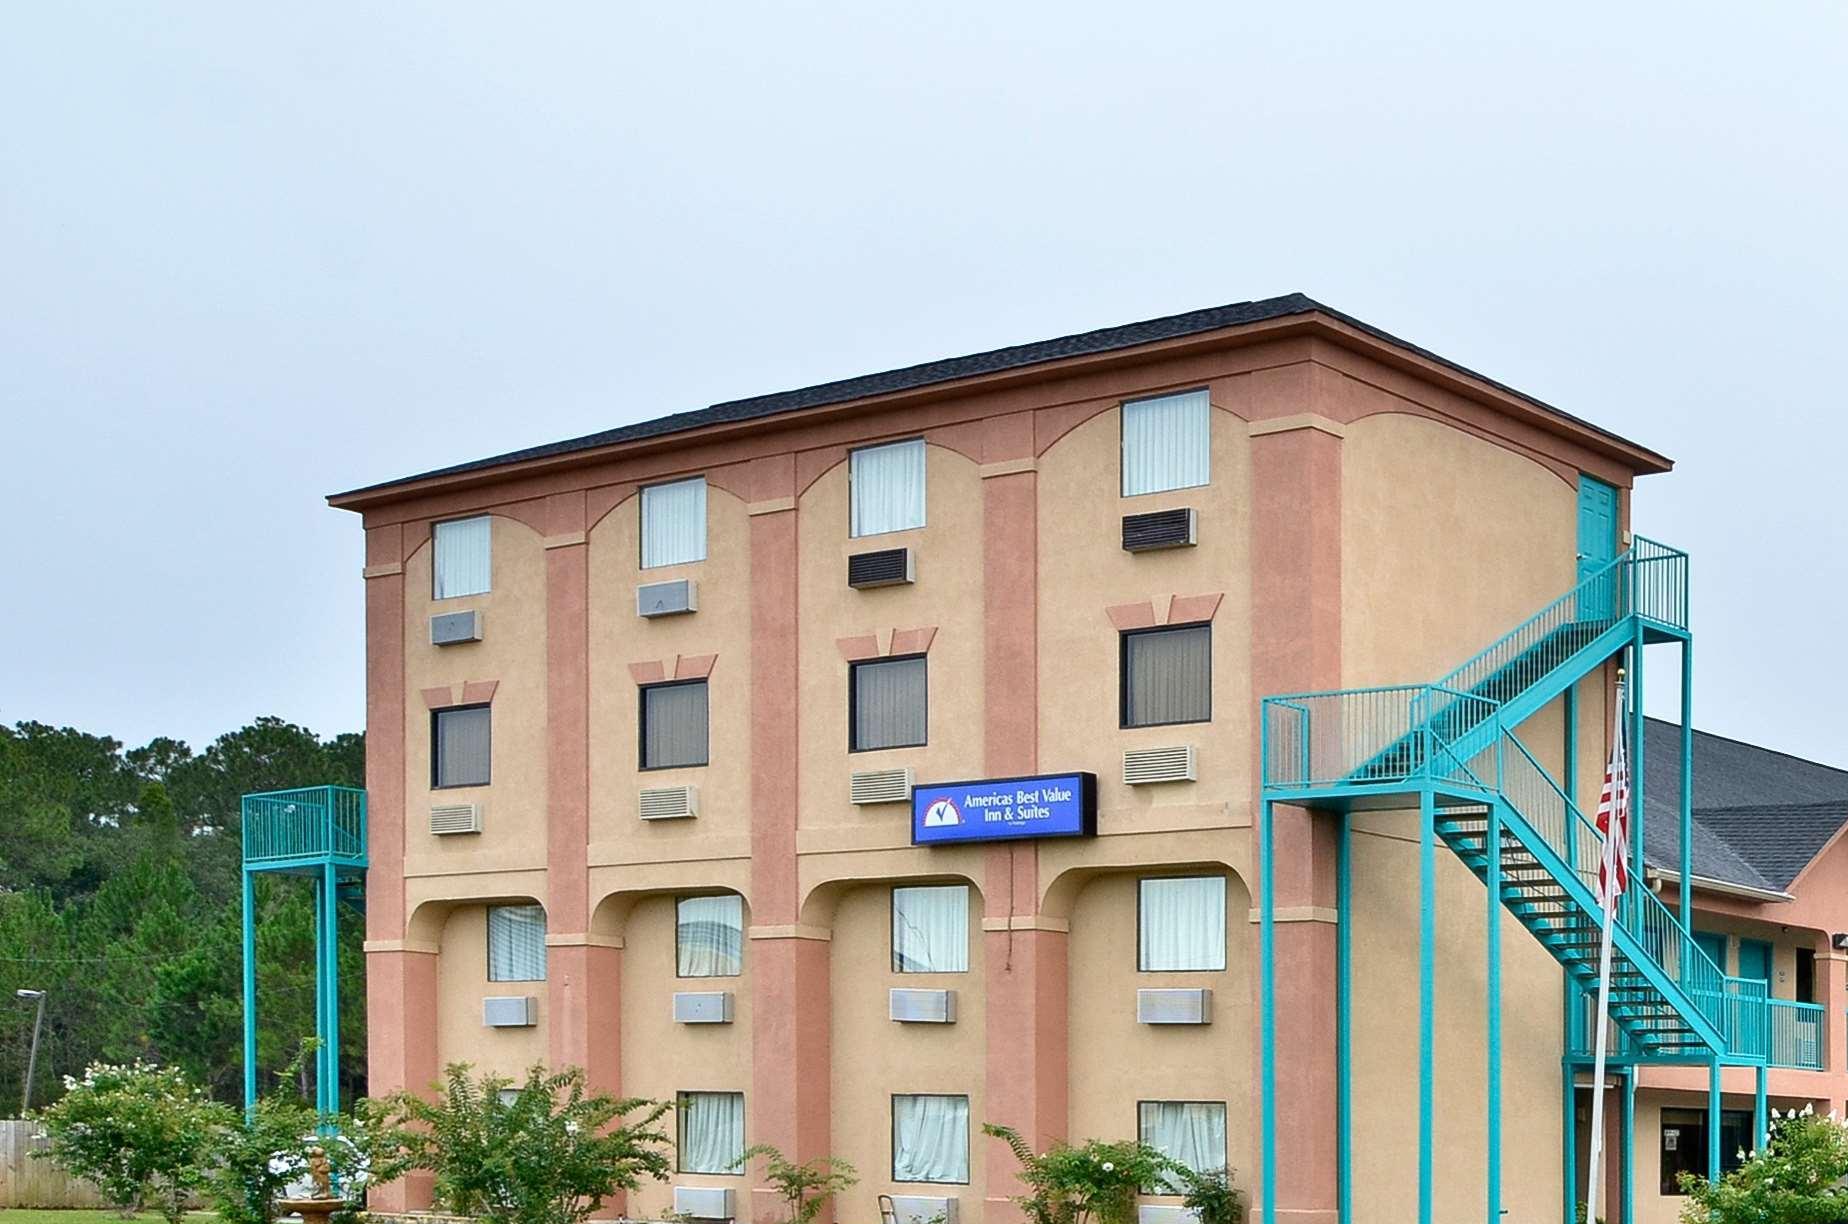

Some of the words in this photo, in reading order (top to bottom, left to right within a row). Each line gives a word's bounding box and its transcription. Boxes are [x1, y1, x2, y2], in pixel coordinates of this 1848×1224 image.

[964, 792, 1013, 808] Americas
[1016, 790, 1039, 804] Best
[1042, 787, 1072, 802] Value
[985, 809, 1002, 822] Inn
[1004, 807, 1014, 820] &
[1017, 805, 1050, 820] Suites
